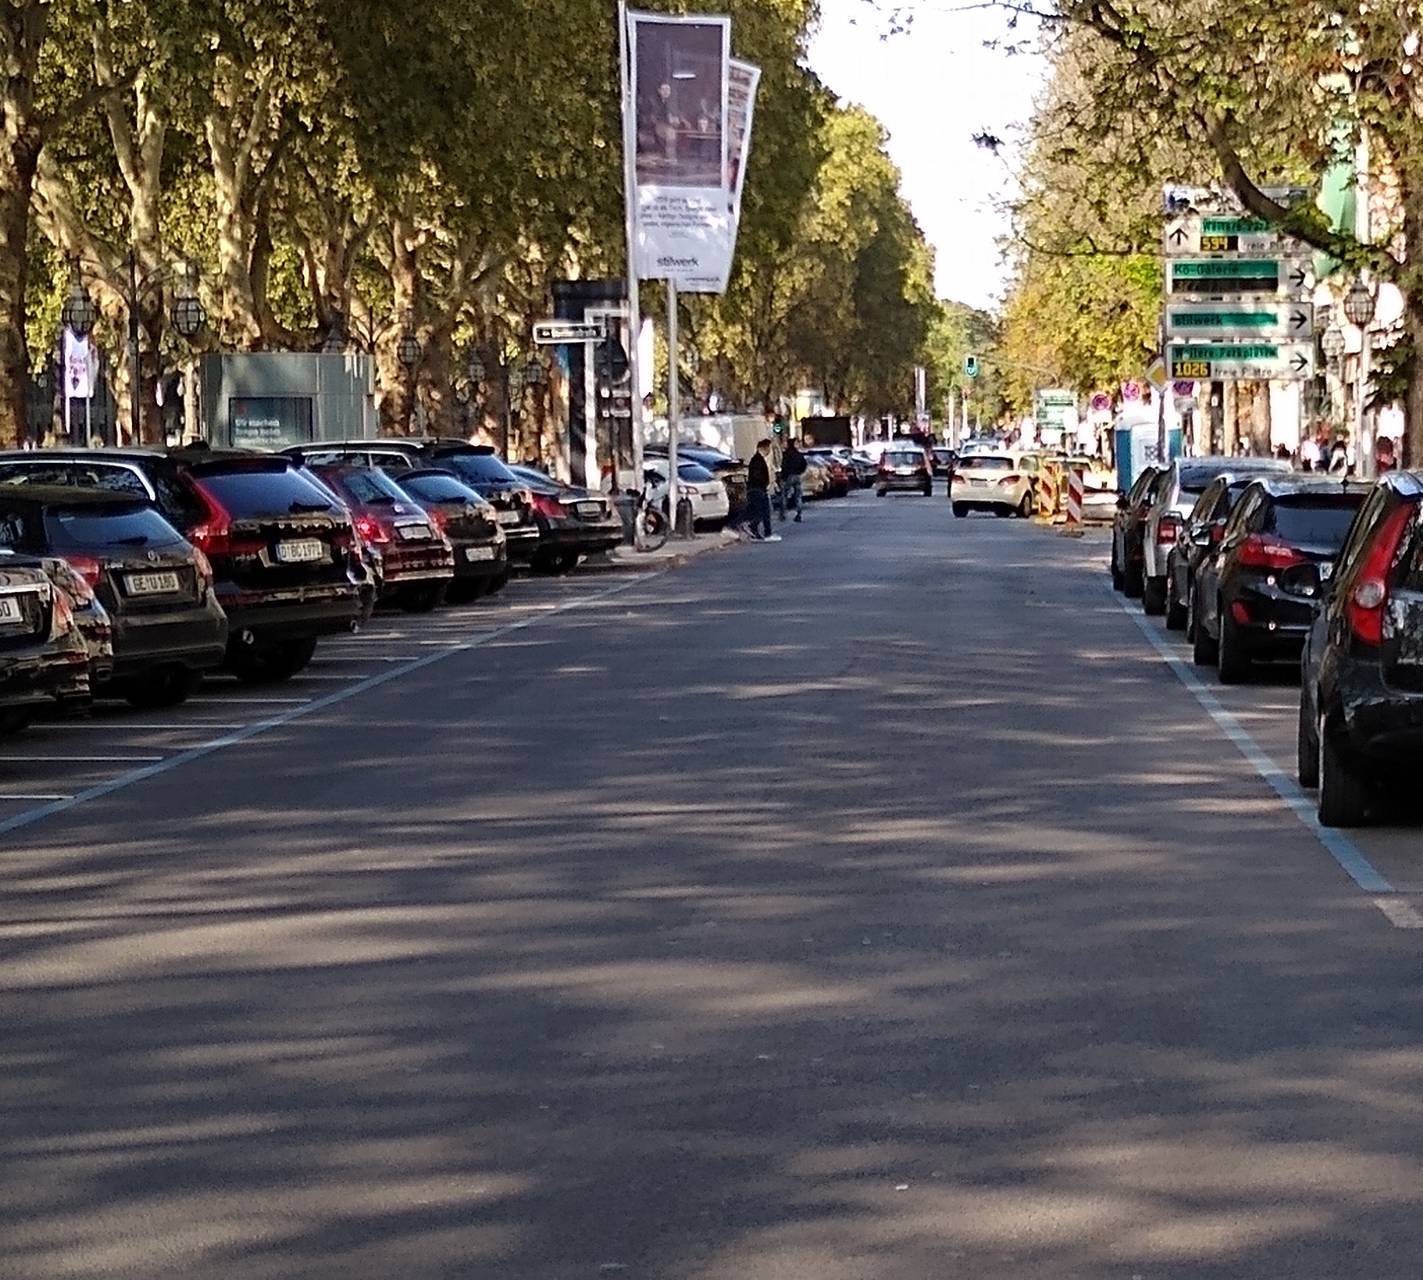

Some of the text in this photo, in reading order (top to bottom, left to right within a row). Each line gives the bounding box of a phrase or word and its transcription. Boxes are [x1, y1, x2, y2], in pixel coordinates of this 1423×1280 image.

[1202, 237, 1228, 250] 594
[1174, 262, 1239, 276] Kö-Galerie
[1174, 314, 1222, 326] stilwerk
[1174, 363, 1208, 377] 1026
